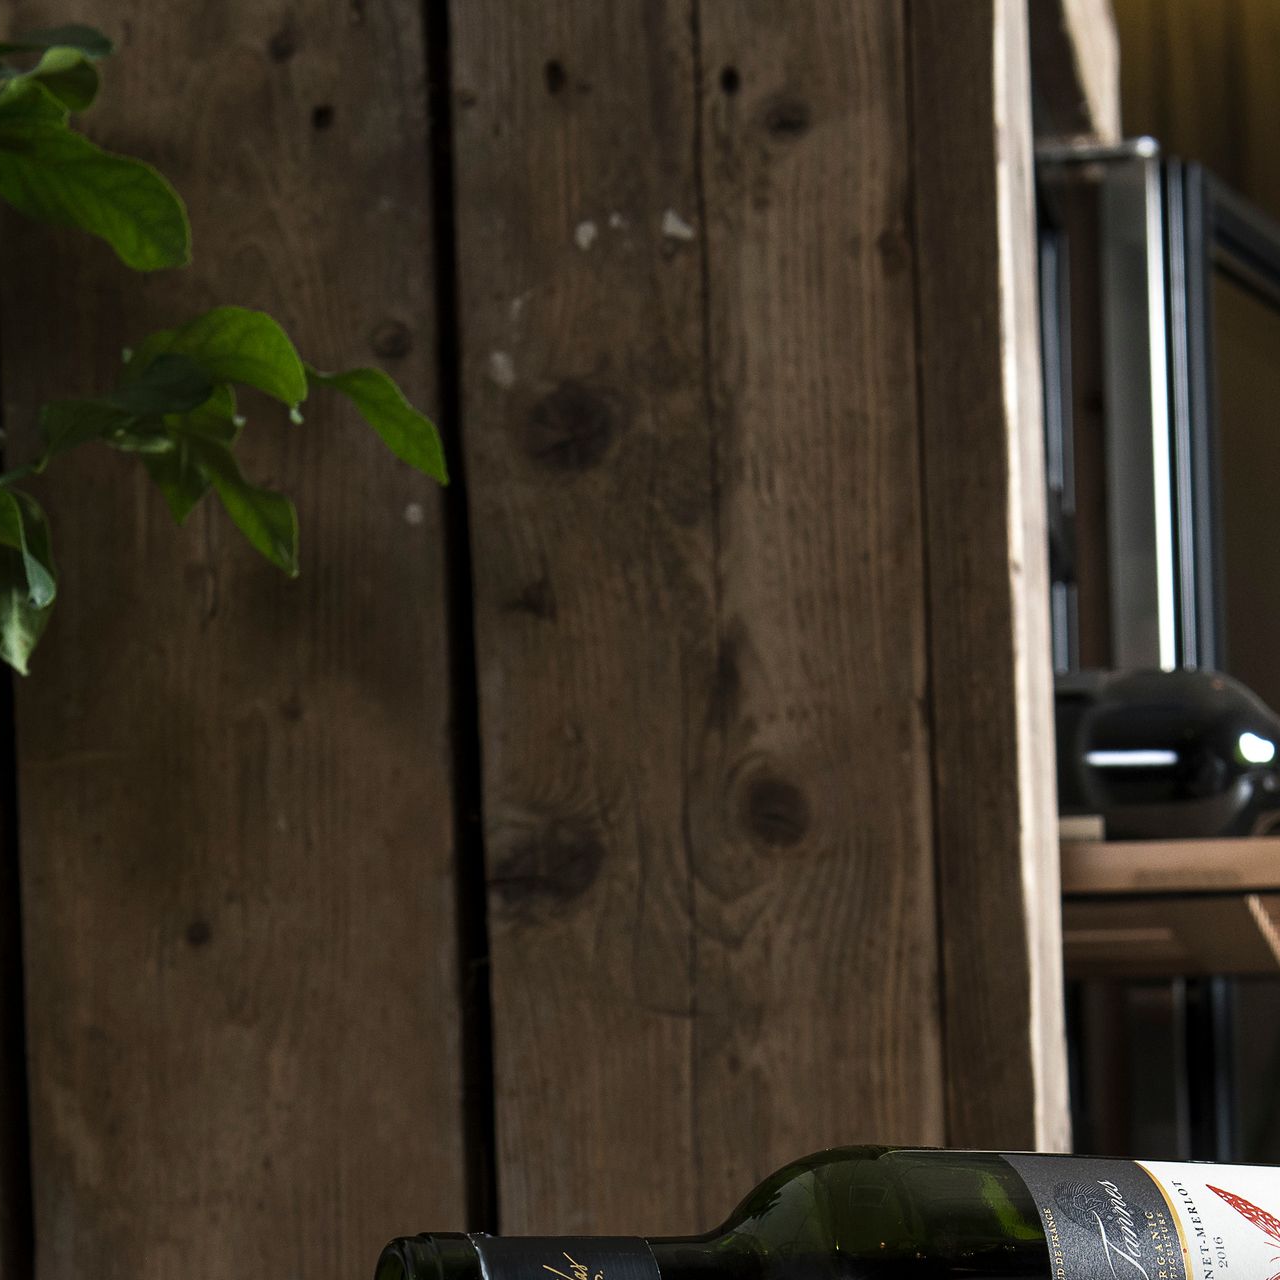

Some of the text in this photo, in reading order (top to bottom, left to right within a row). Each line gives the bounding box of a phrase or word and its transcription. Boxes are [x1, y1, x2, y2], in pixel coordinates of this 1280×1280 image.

[1043, 1208, 1061, 1249] FRANCE
[1054, 1250, 1064, 1266] DE
[1213, 1236, 1229, 1268] 2016
